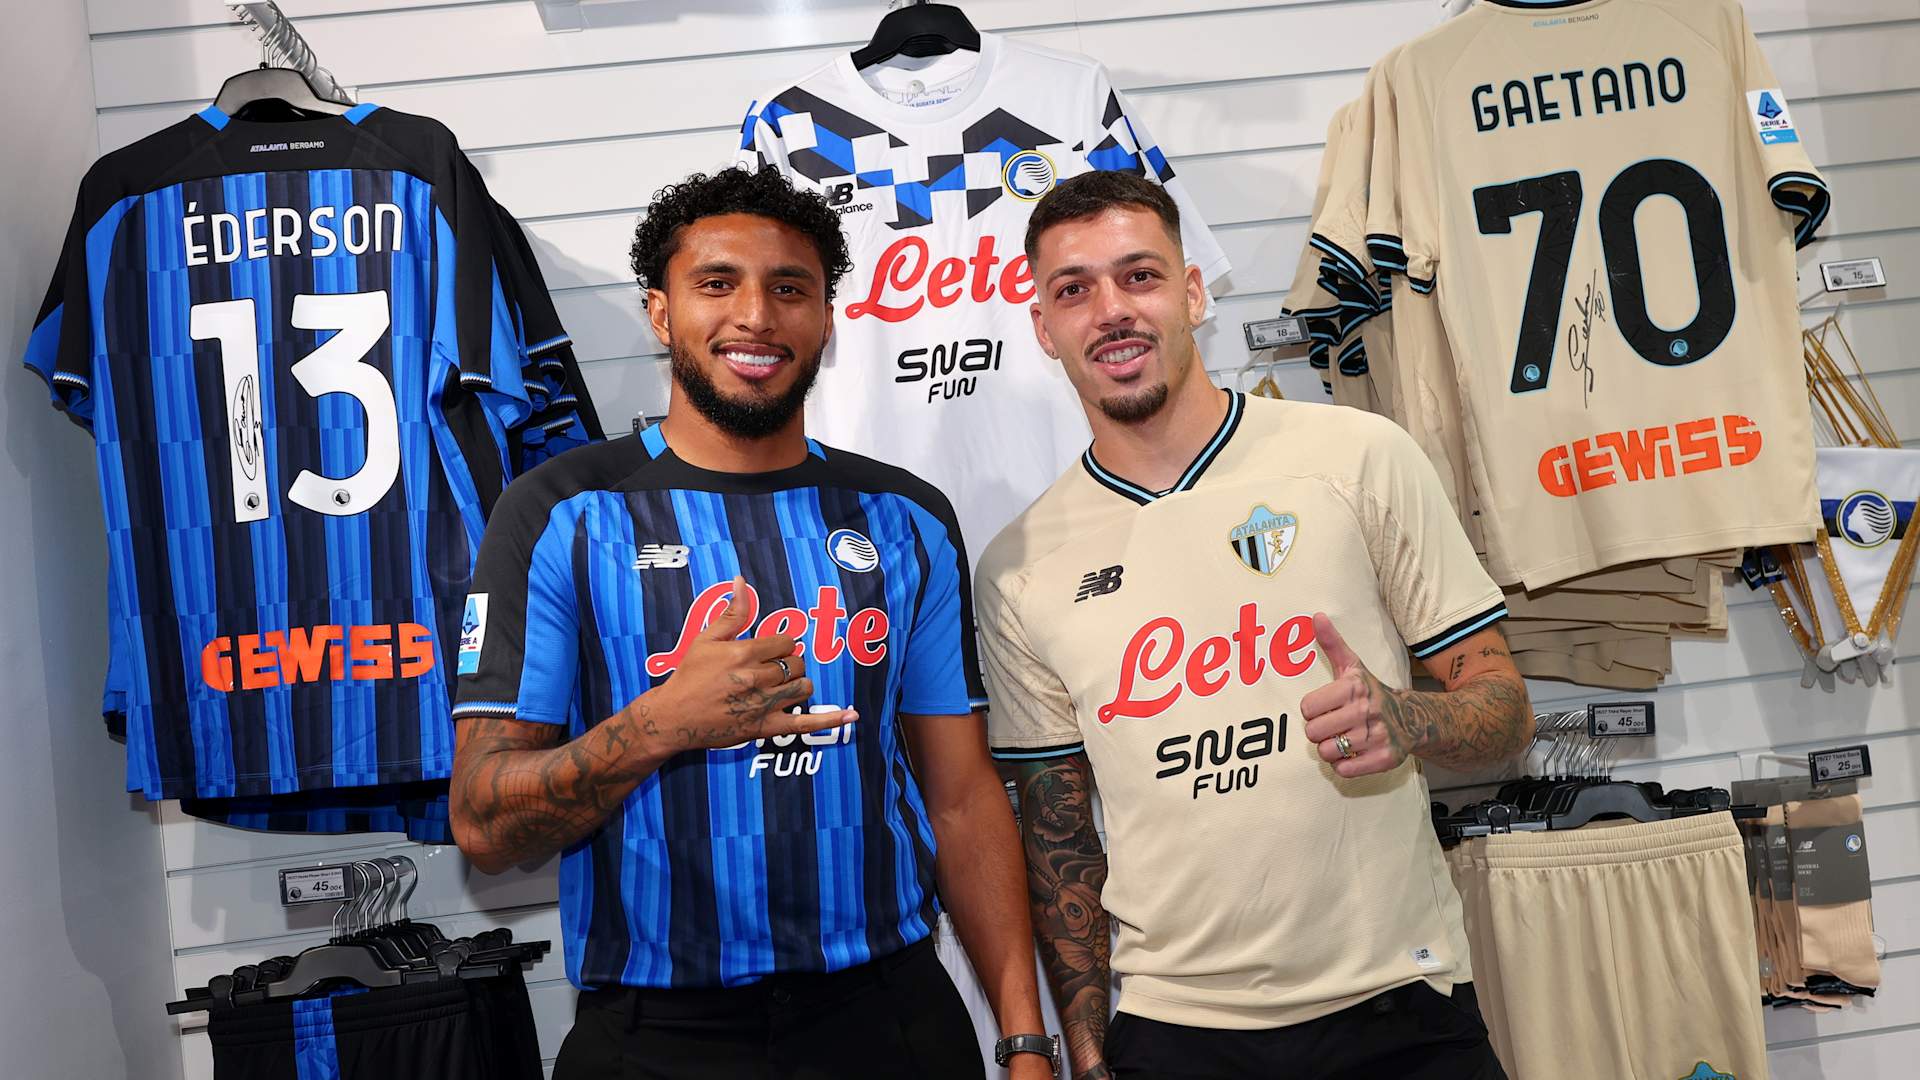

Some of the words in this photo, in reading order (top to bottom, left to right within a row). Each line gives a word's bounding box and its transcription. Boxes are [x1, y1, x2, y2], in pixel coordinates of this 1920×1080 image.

[1471, 57, 1687, 133] GAETANO
[250, 143, 288, 153] ATALANTA
[289, 141, 325, 150] BERGAMO
[834, 202, 873, 215] alance
[183, 201, 404, 267] ÉDERSON
[845, 235, 1037, 323] Lete
[1472, 157, 1737, 394] 70
[1276, 328, 1288, 337] 18
[928, 376, 977, 404] FUN
[188, 289, 401, 523] 13
[1235, 515, 1290, 537] ATALANTA
[632, 544, 690, 570] NB
[1074, 564, 1124, 603] NB
[645, 580, 890, 677] Lete
[1097, 601, 1316, 725] Lete
[1617, 716, 1633, 727] 45
[749, 750, 823, 779] FUN
[1838, 760, 1851, 771] 25
[1193, 764, 1258, 800] FUN
[312, 880, 329, 892] 45
